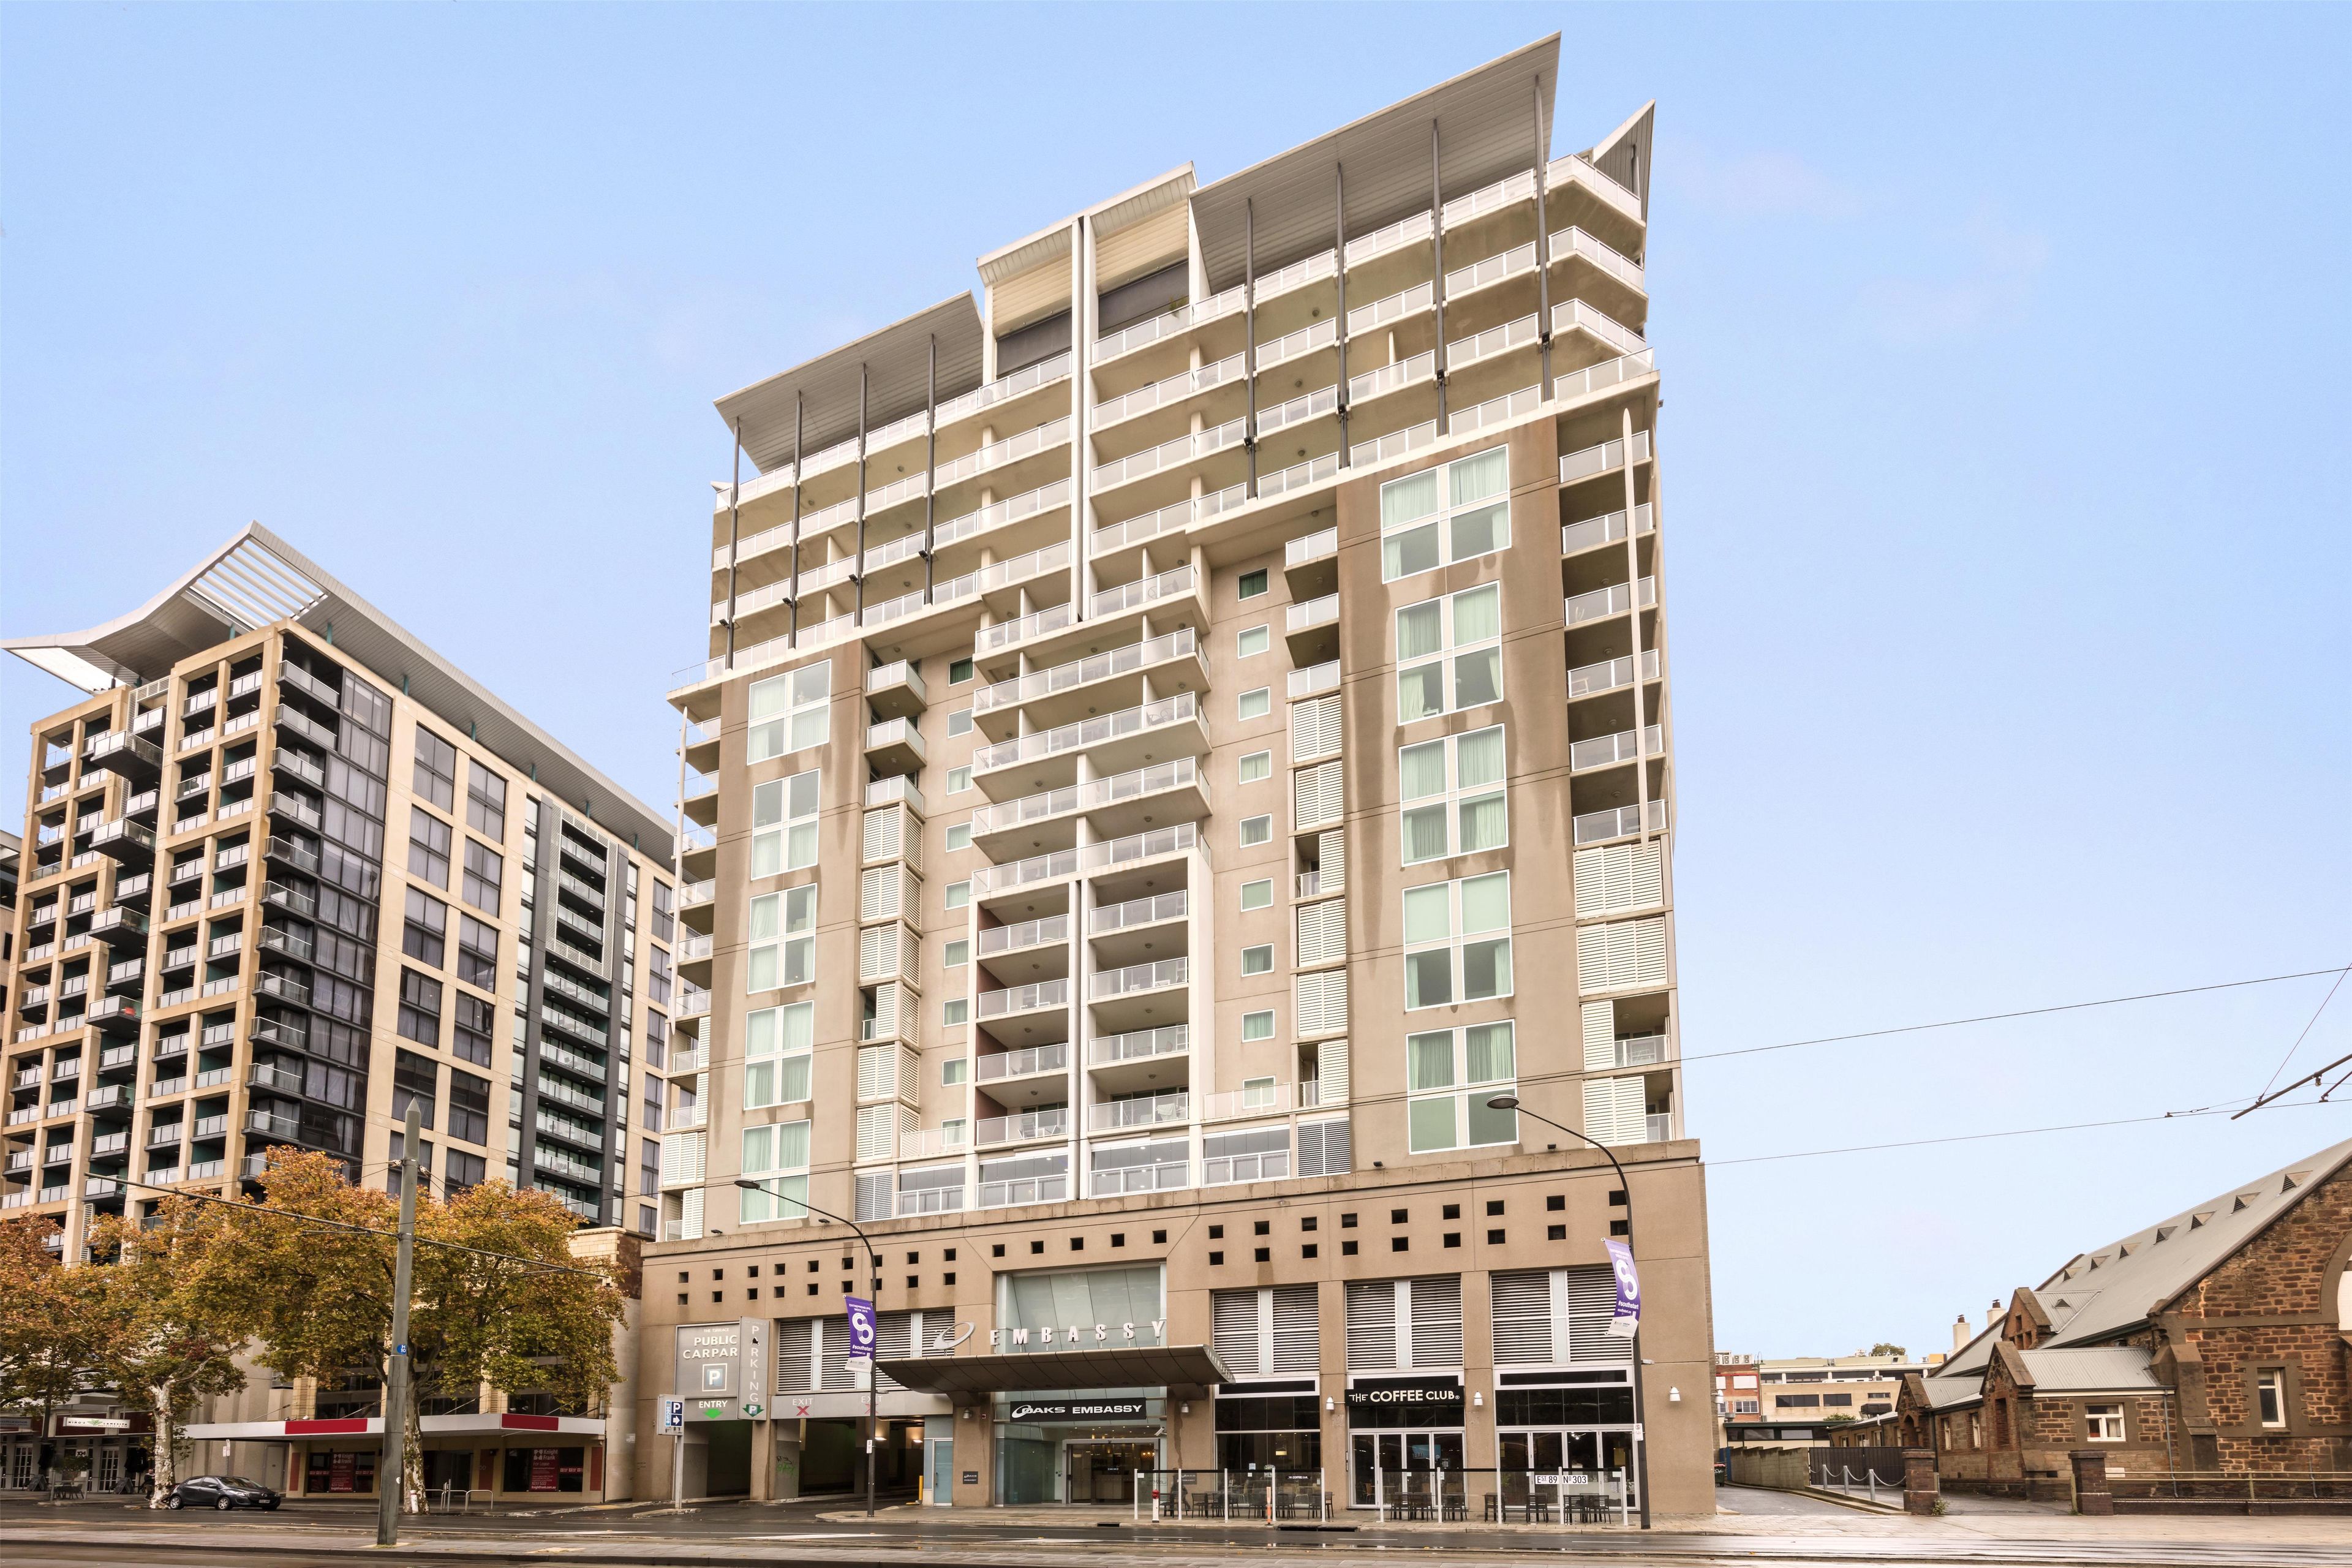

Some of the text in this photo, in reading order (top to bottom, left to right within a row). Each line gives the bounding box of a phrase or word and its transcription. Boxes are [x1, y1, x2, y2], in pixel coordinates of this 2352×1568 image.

[1618, 1300, 1639, 1310] #southstart
[990, 1321, 1167, 1346] EMBASSY
[694, 1335, 737, 1346] PUBLIC
[683, 1348, 738, 1359] CARPAR
[1349, 1393, 1369, 1403] THE
[1370, 1389, 1423, 1403] COFFEE
[1072, 1404, 1142, 1414] EMBASSY
